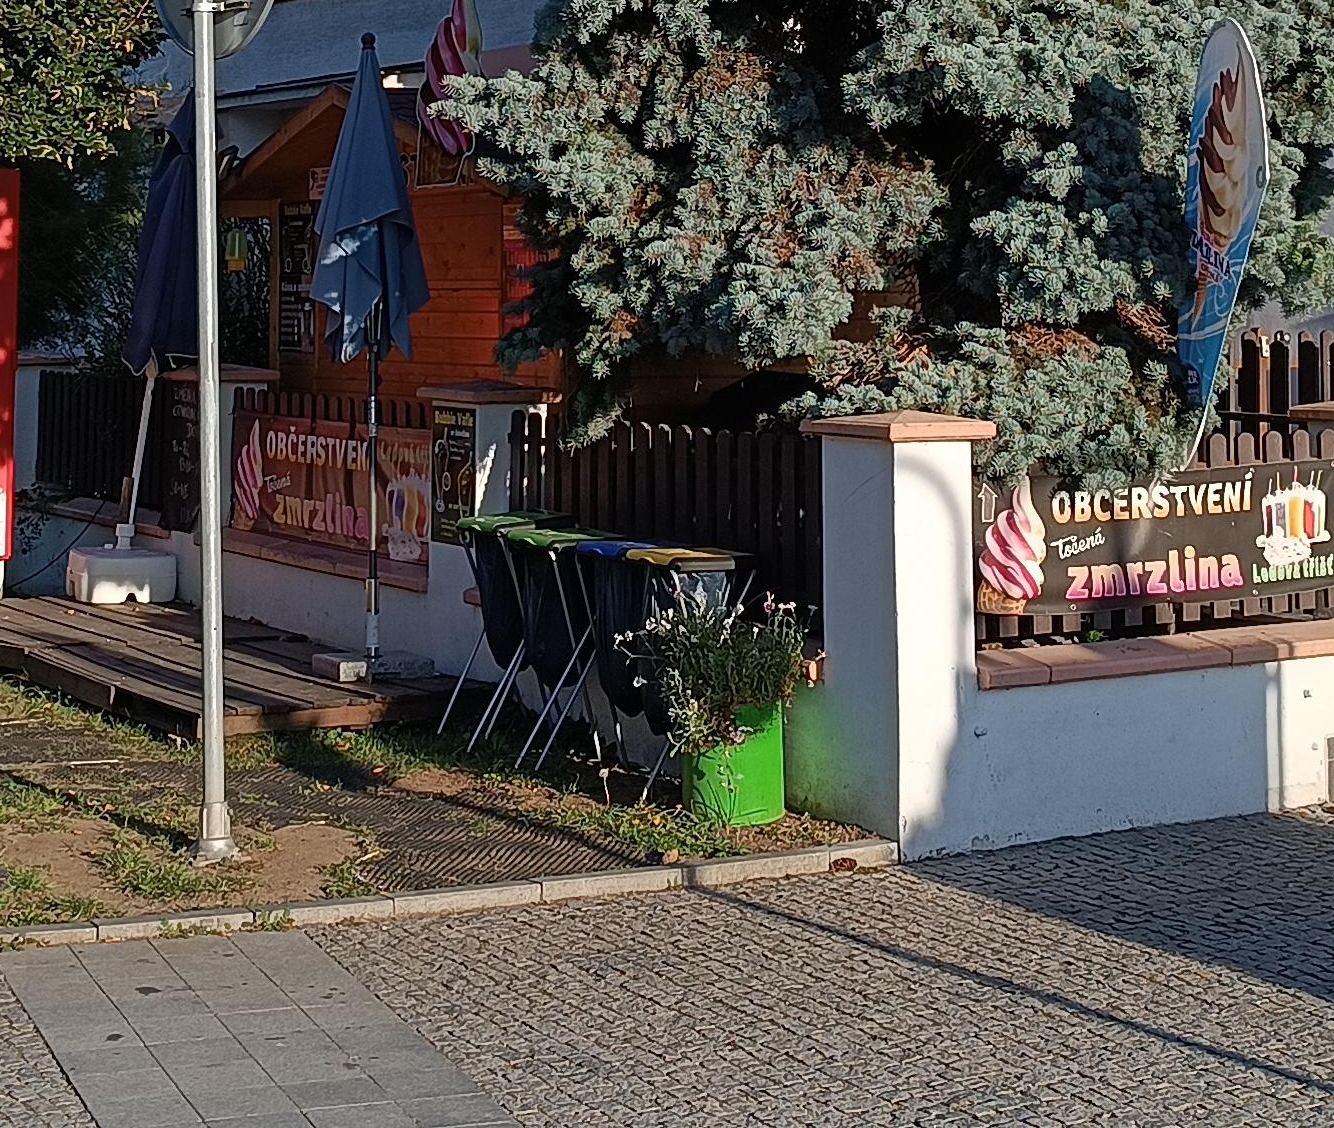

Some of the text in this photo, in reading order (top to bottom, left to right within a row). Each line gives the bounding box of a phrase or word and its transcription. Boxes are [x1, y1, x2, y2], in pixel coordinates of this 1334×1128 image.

[267, 425, 371, 472] OBČERSTVEN
[273, 492, 369, 540] zmrzlina
[1050, 527, 1106, 560] Točená
[1066, 545, 1244, 600] zmrzlina
